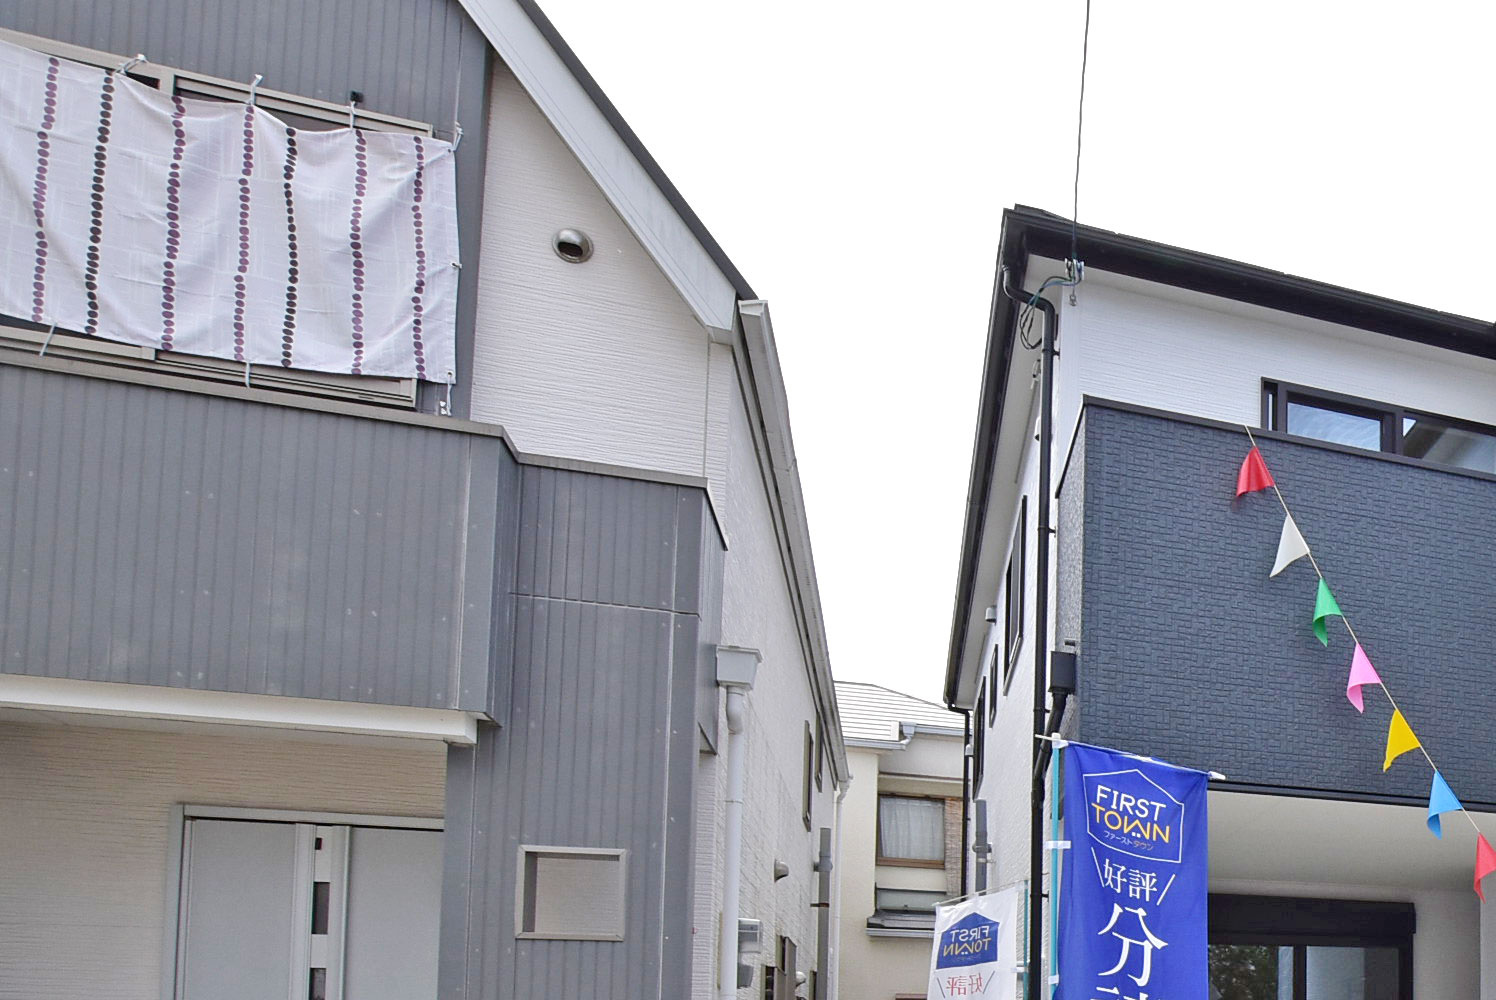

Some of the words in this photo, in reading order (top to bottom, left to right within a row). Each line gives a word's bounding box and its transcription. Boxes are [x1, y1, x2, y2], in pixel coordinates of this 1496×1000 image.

[1096, 785, 1166, 821] FIRST
[1091, 802, 1170, 843] TOWN
[1104, 830, 1153, 851] ファーストタウン
[1103, 858, 1158, 902] 好評
